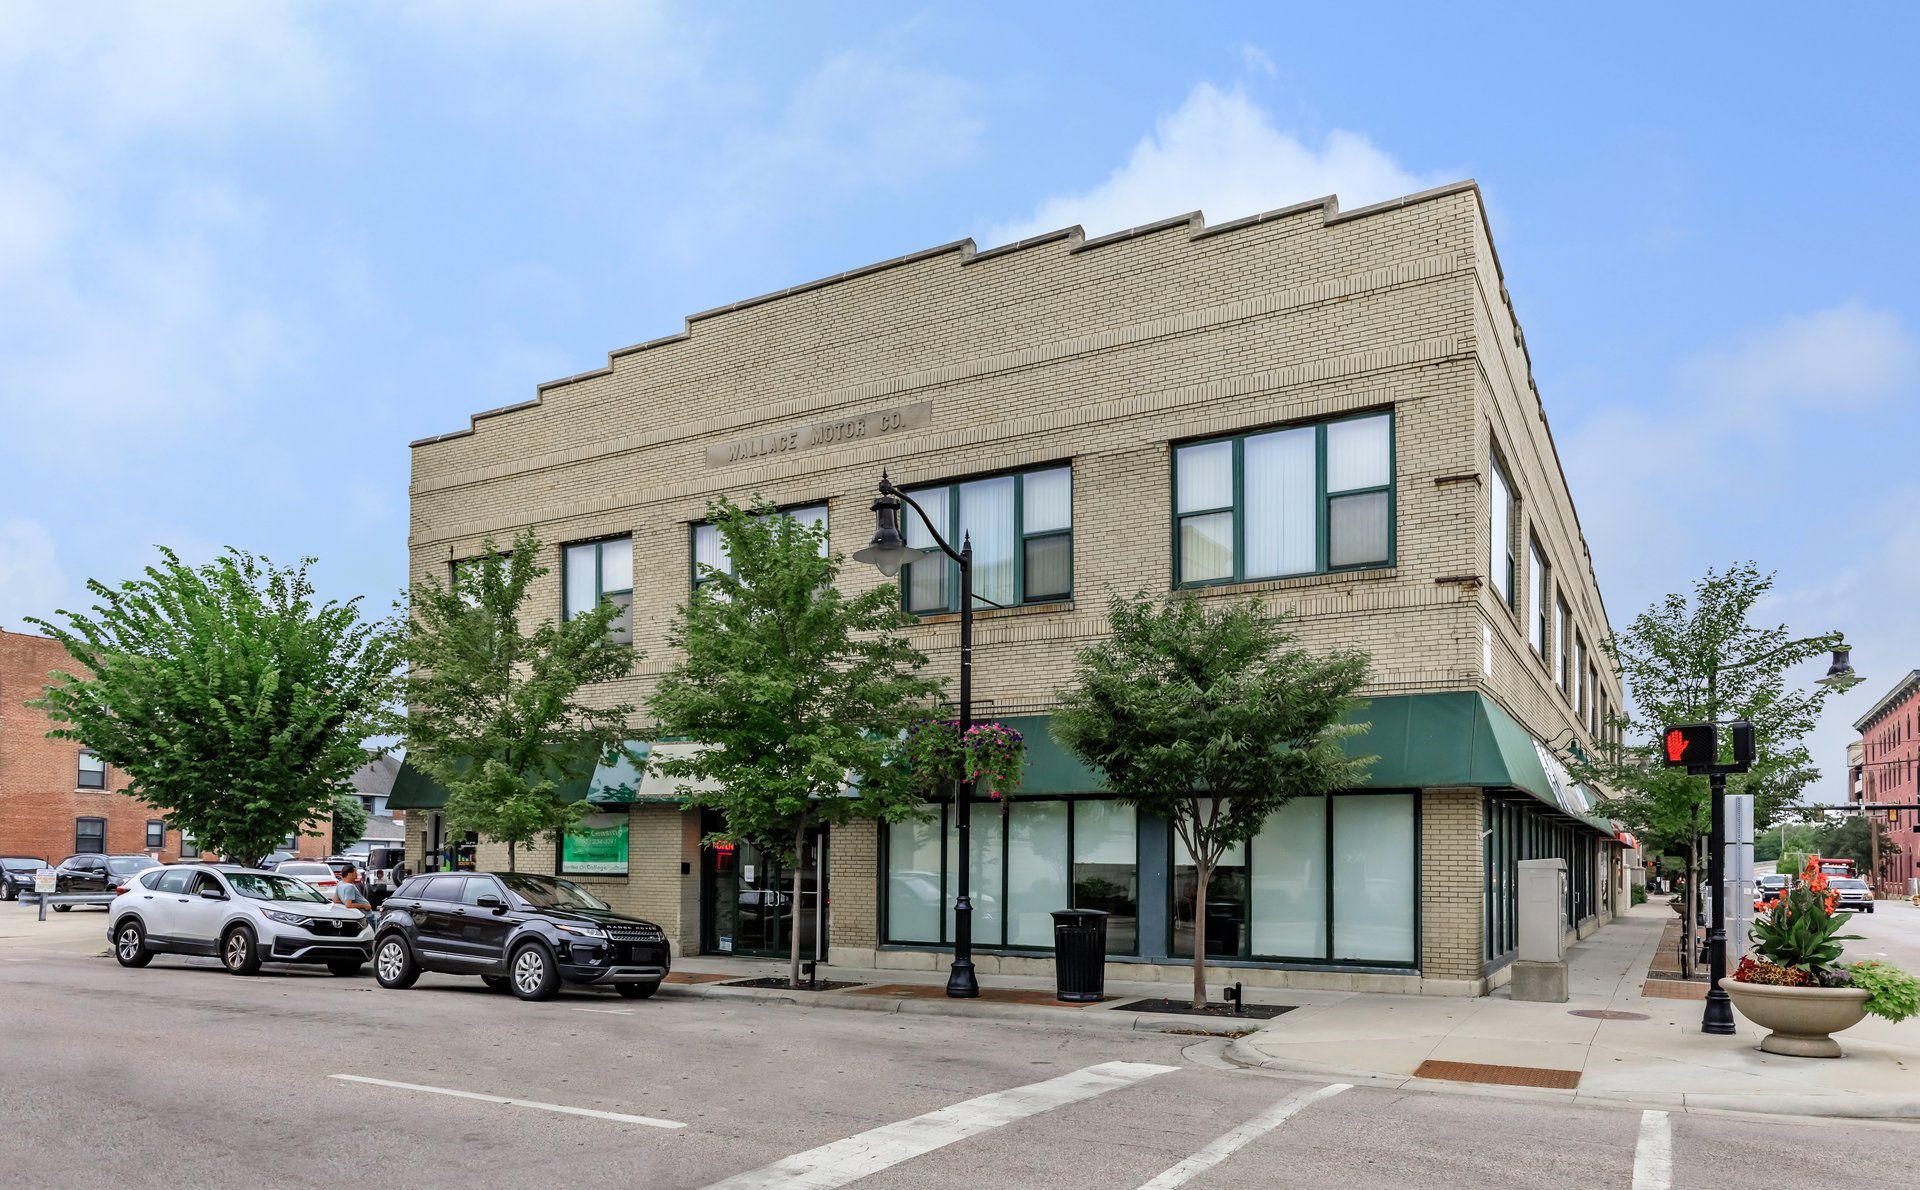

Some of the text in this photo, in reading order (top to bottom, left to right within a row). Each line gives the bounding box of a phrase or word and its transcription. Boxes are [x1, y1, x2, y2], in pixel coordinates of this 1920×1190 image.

[729, 412, 906, 462] WALLACE MOTOR CO.
